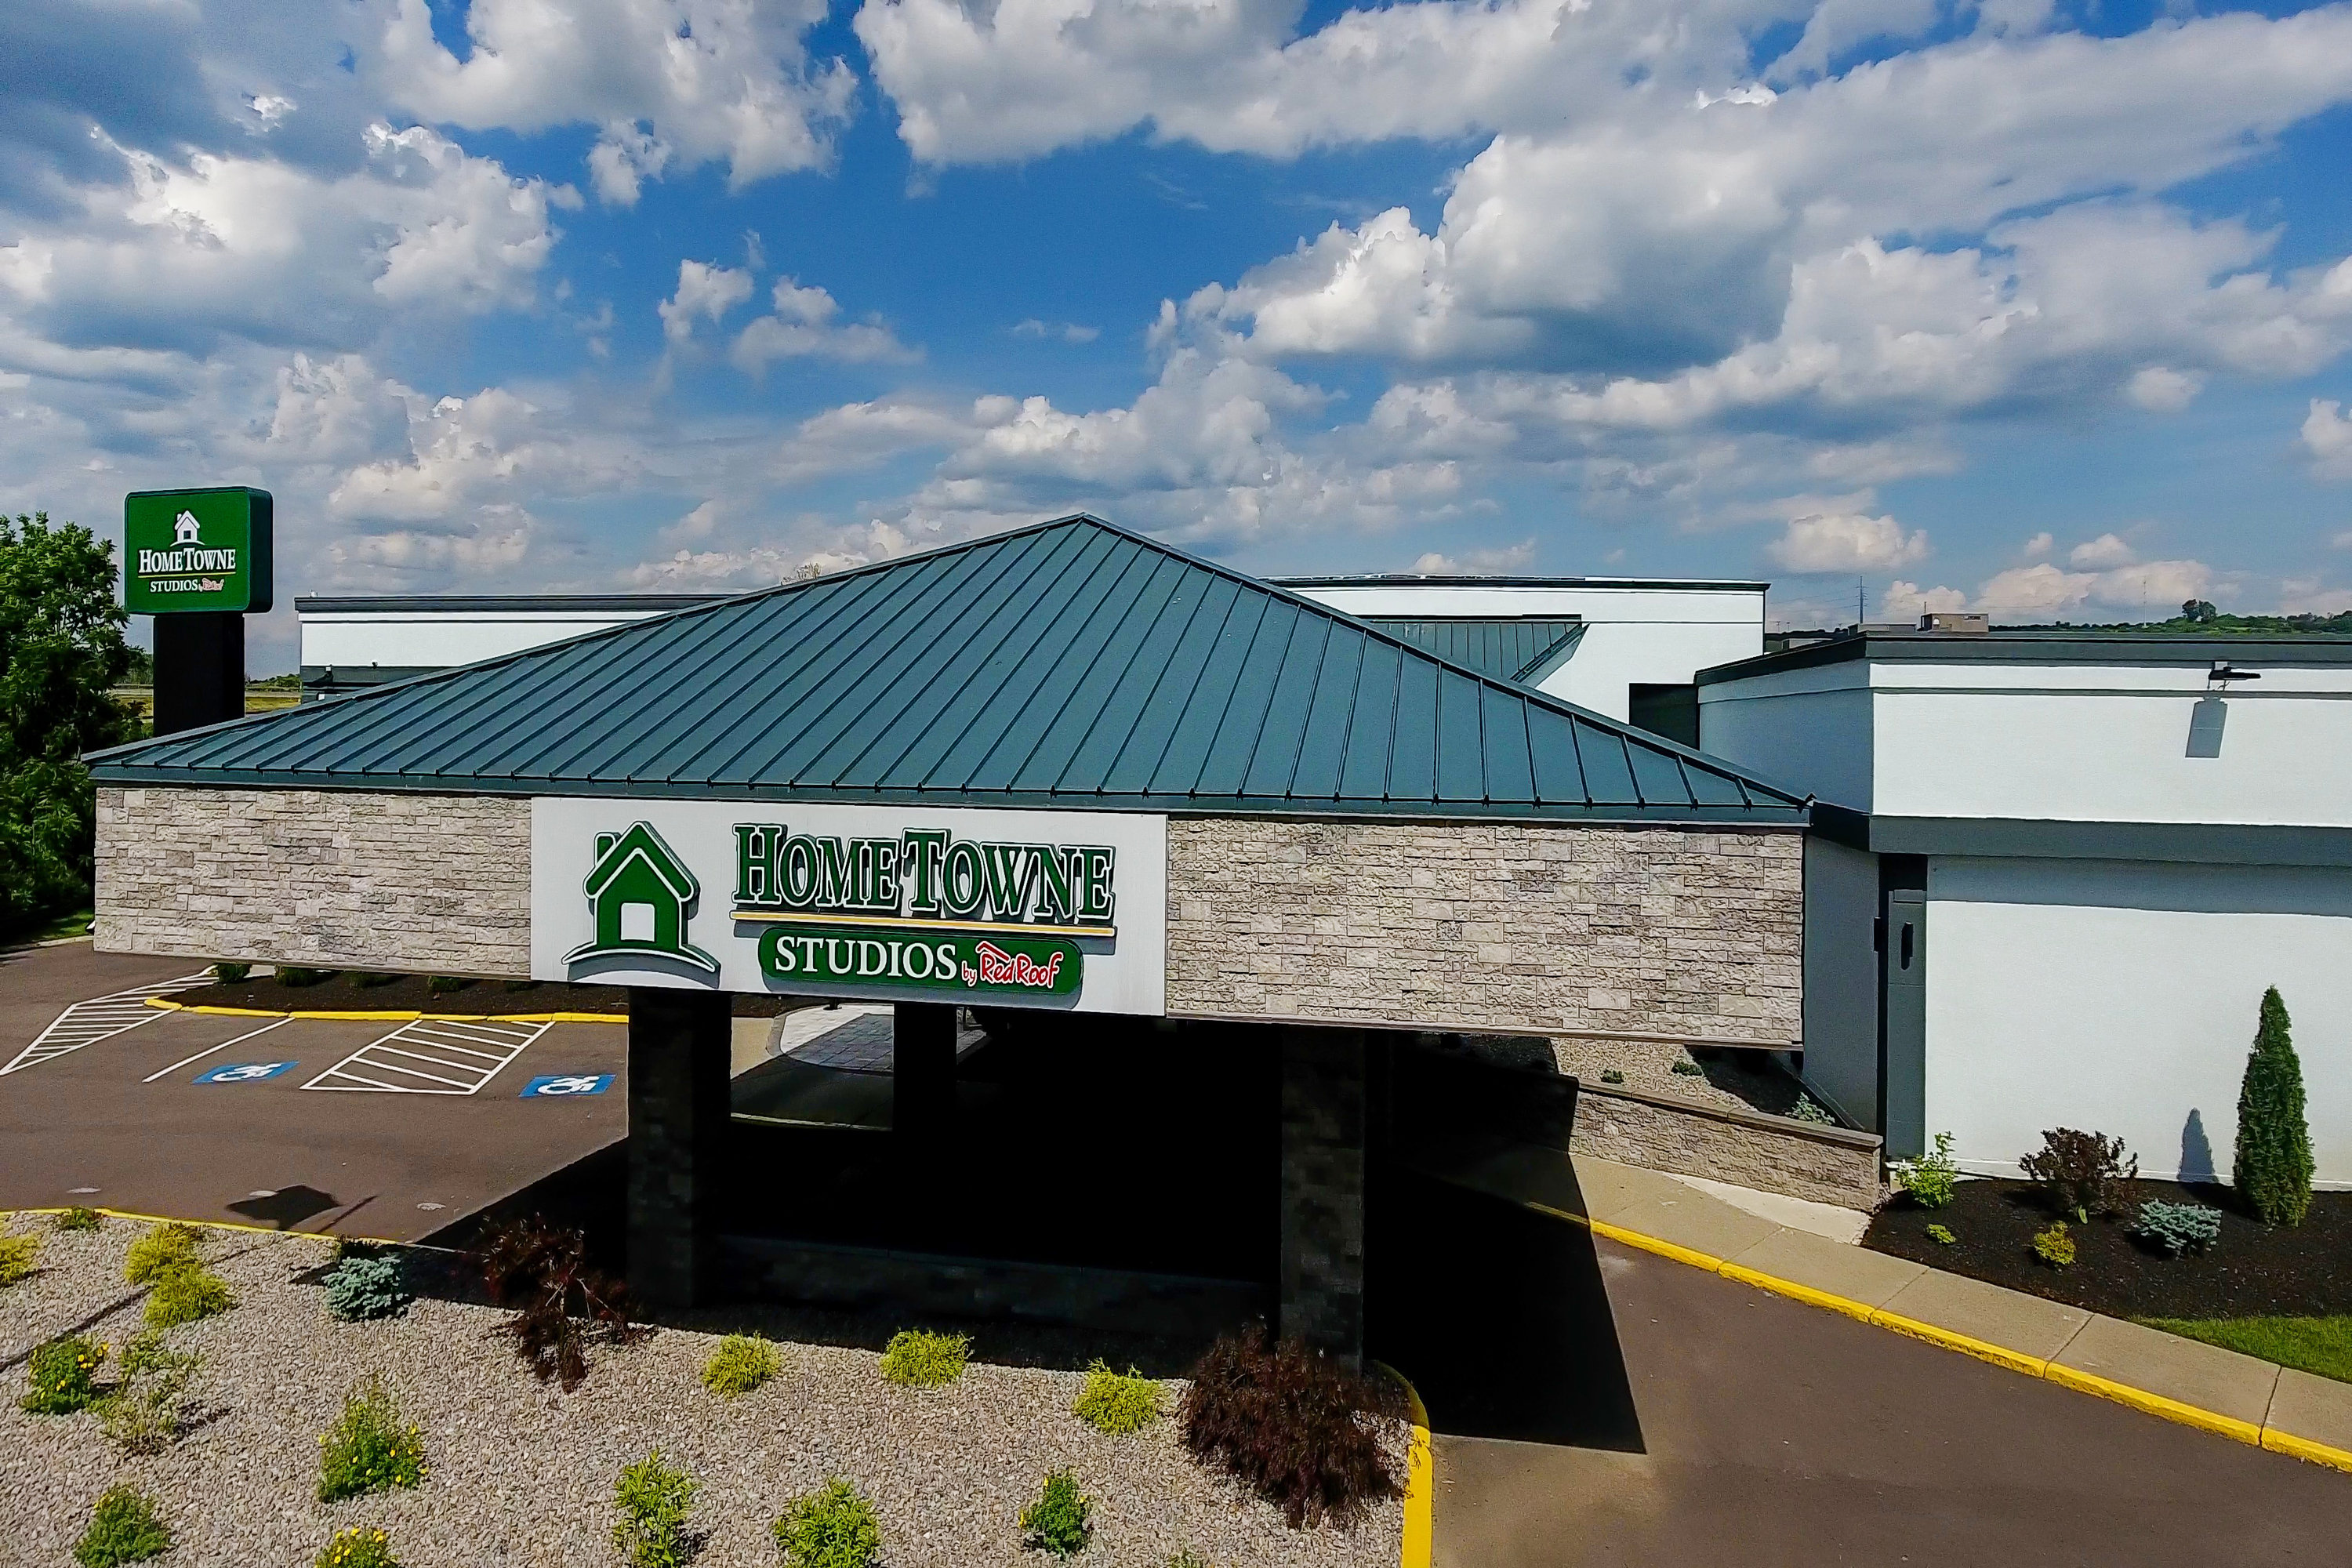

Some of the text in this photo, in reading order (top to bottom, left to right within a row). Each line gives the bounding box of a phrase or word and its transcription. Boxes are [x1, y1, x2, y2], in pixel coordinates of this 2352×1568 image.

[150, 579, 198, 592] STUDIOS
[775, 936, 957, 979] STUDIOS
[961, 960, 978, 987] by
